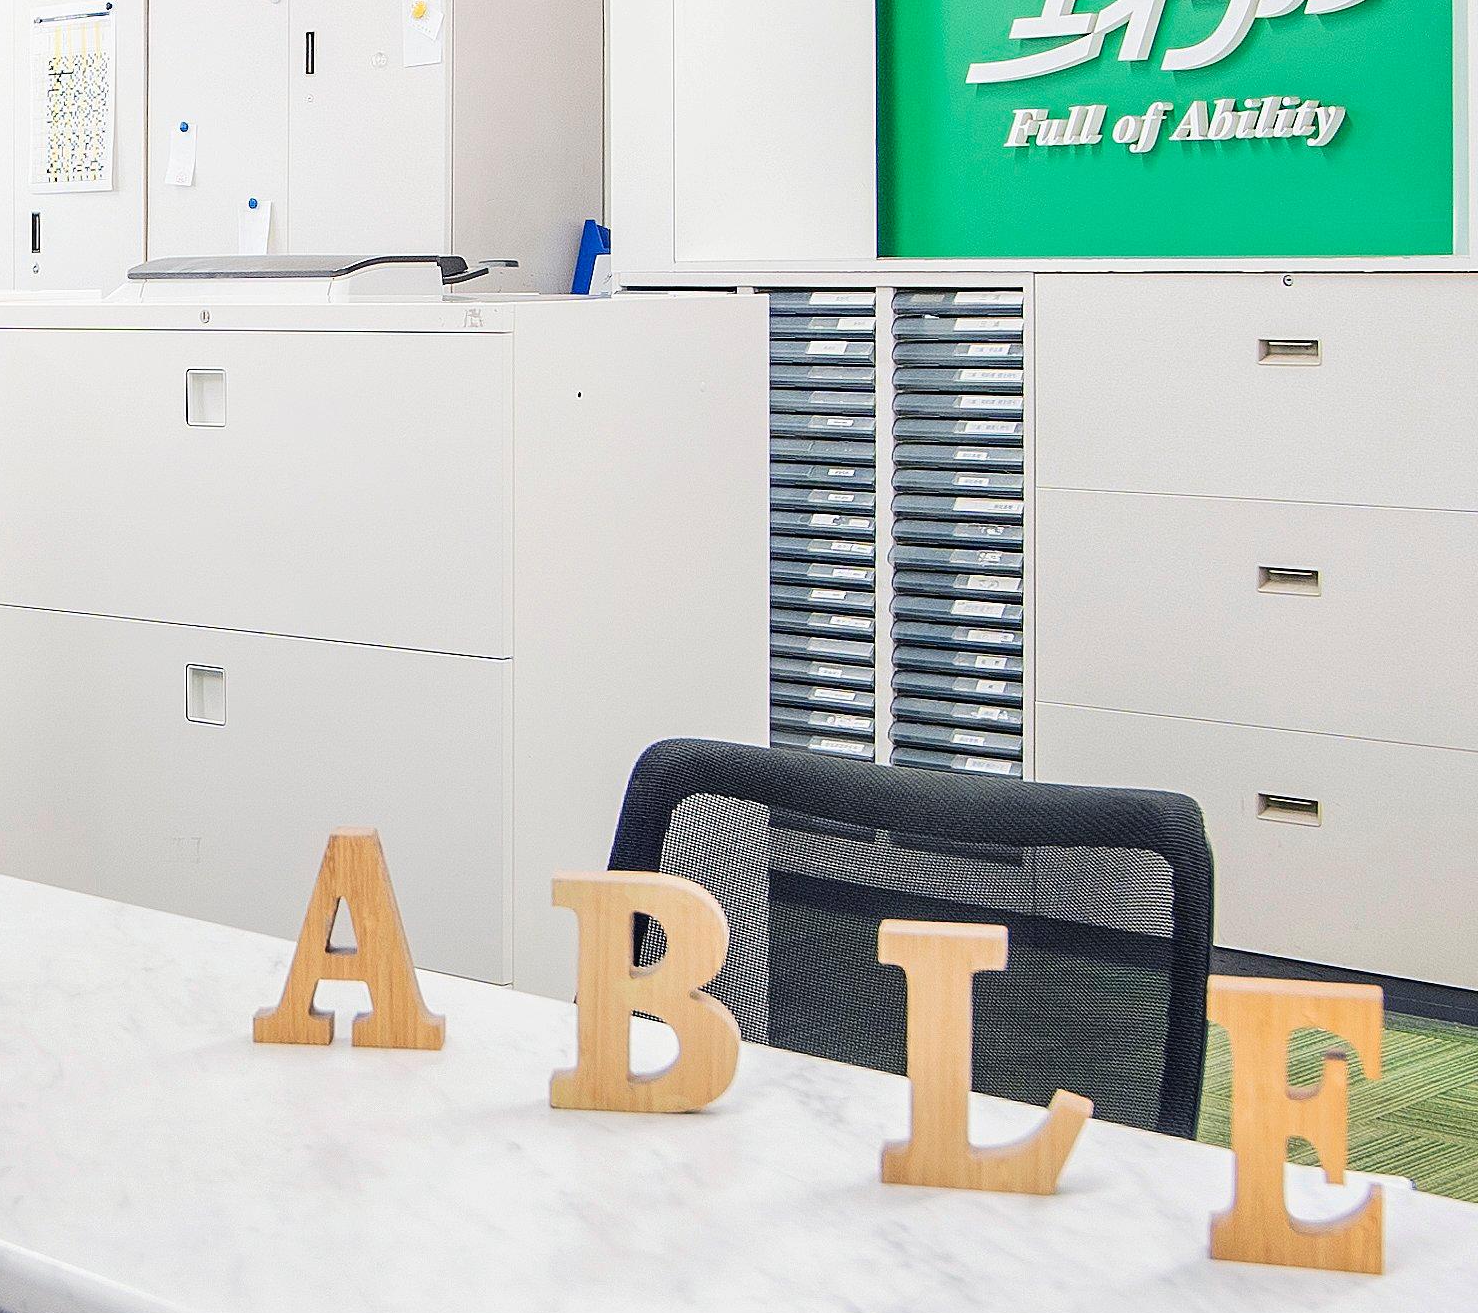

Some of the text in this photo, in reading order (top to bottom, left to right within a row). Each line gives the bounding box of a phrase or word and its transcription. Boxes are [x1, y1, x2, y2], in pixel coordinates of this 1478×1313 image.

[1003, 96, 1346, 154] Full of Ability
